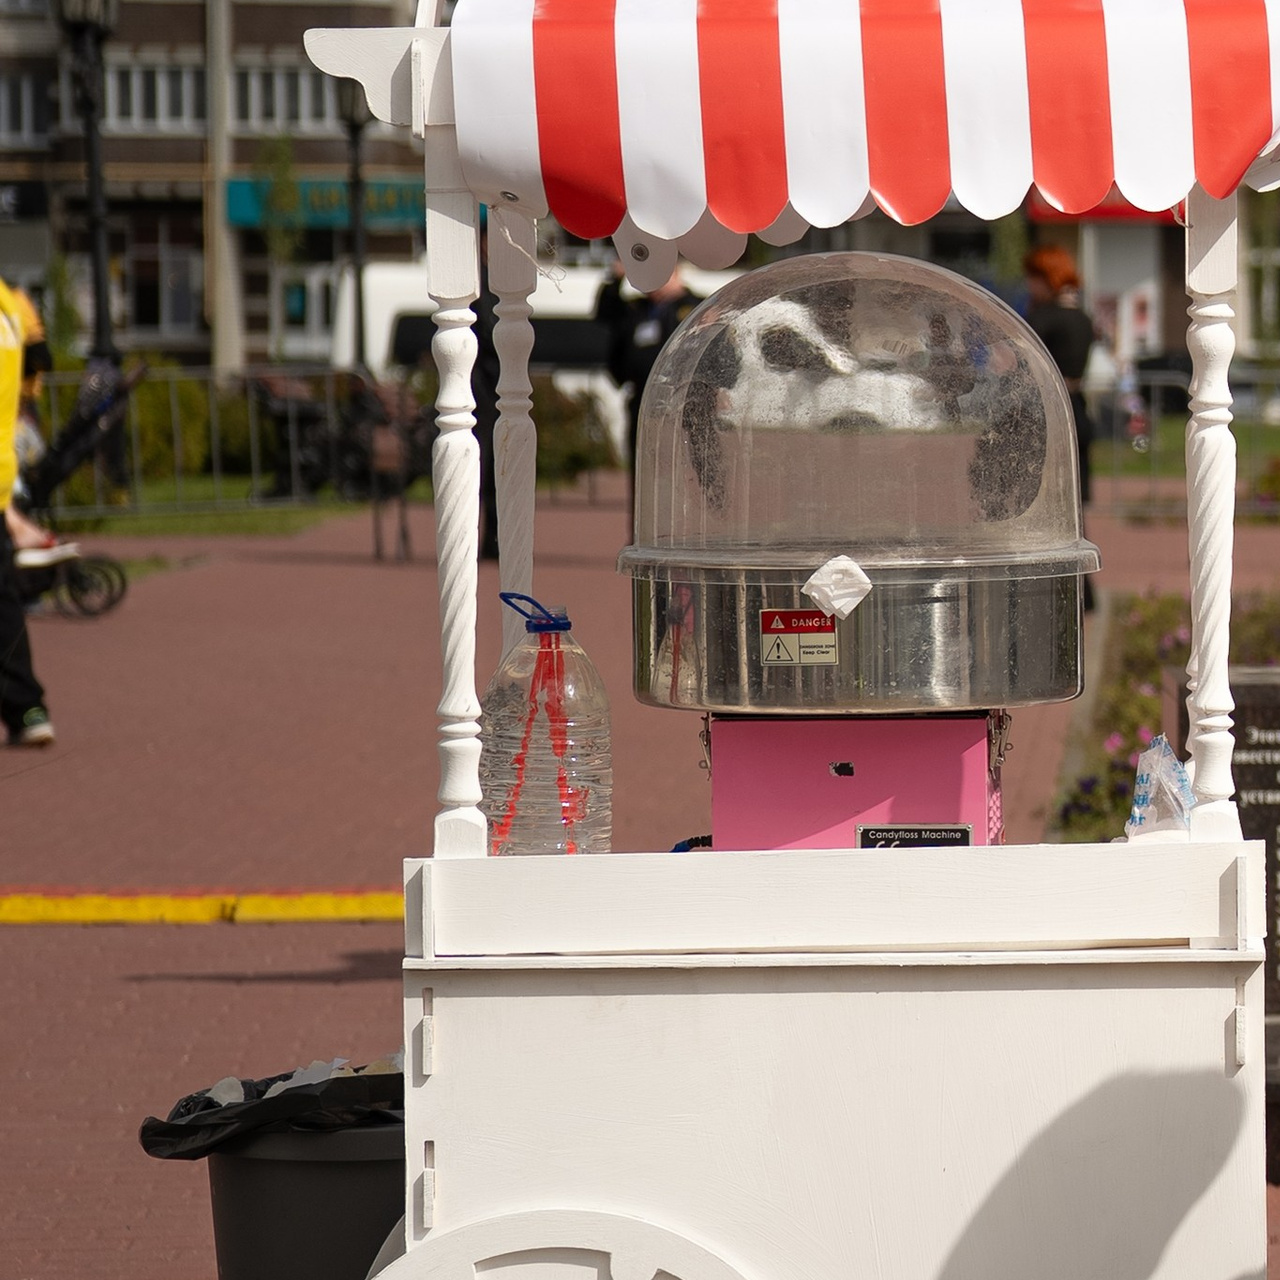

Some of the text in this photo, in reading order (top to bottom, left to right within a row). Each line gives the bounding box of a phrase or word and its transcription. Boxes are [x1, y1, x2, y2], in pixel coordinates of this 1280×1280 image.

[791, 617, 832, 627] DANGER
[868, 830, 962, 840] Candyfloss Machine
